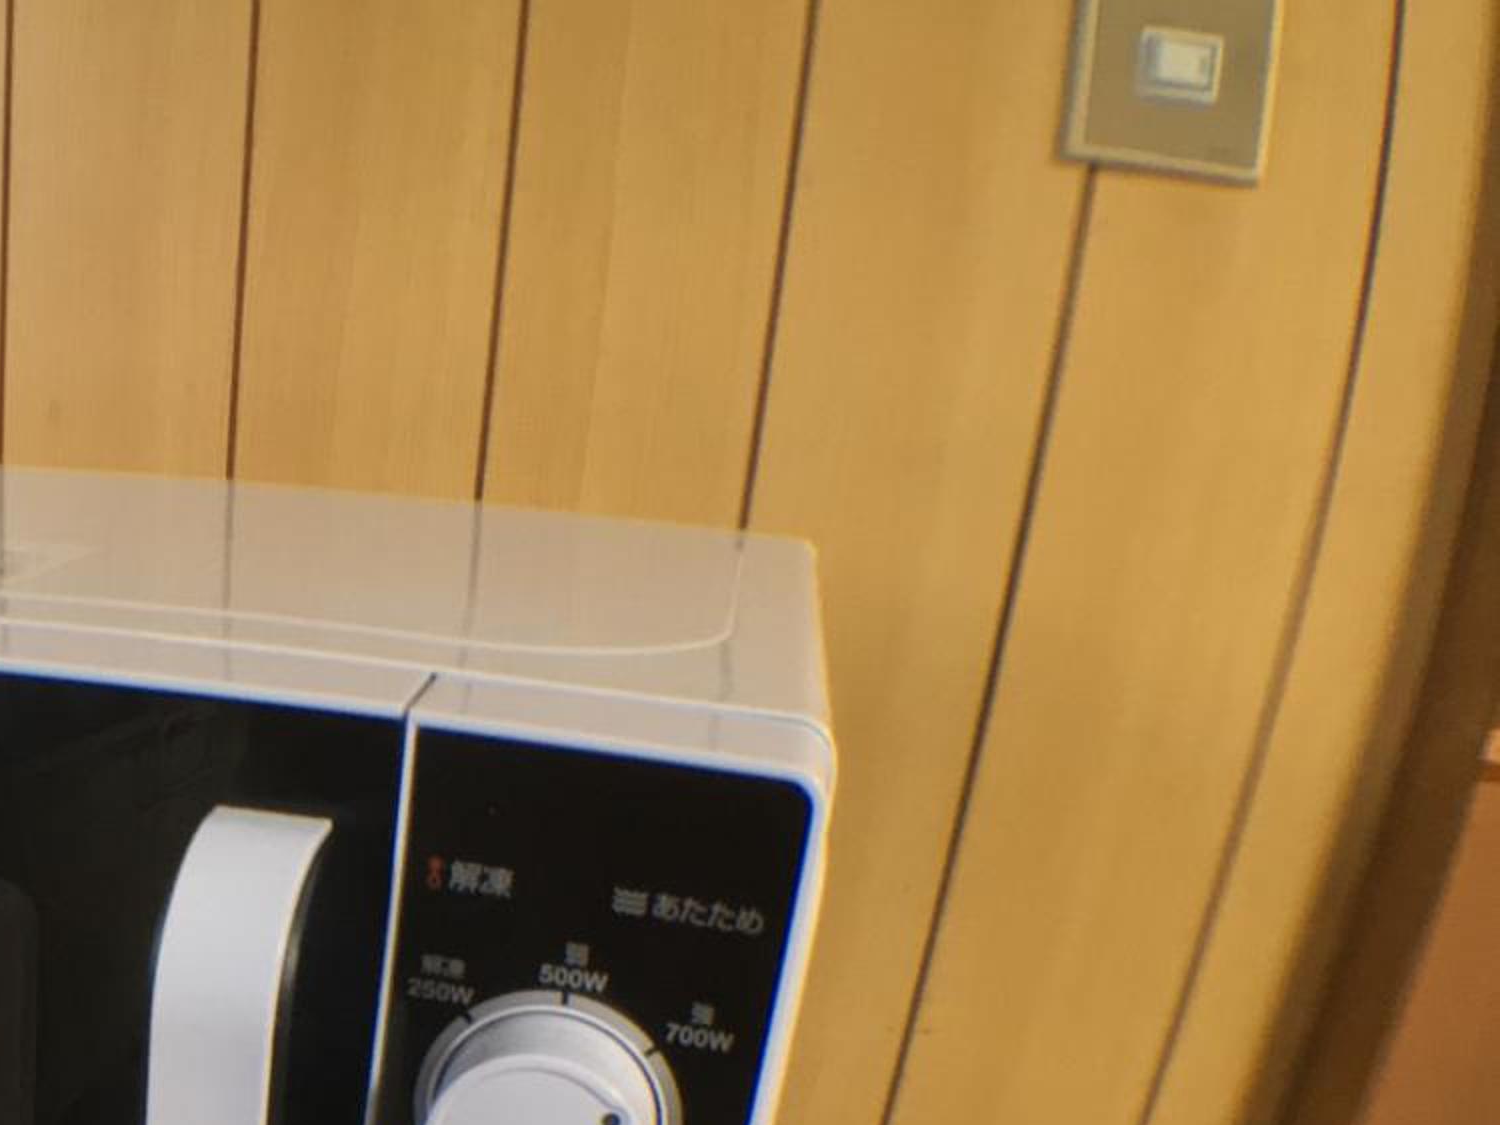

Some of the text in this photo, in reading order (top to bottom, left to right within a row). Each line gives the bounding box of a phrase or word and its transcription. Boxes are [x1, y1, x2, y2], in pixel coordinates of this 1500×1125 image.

[652, 893, 764, 934] あたため
[406, 976, 475, 1005] 250W
[539, 963, 609, 992] 500W
[666, 1022, 735, 1053] 700W
